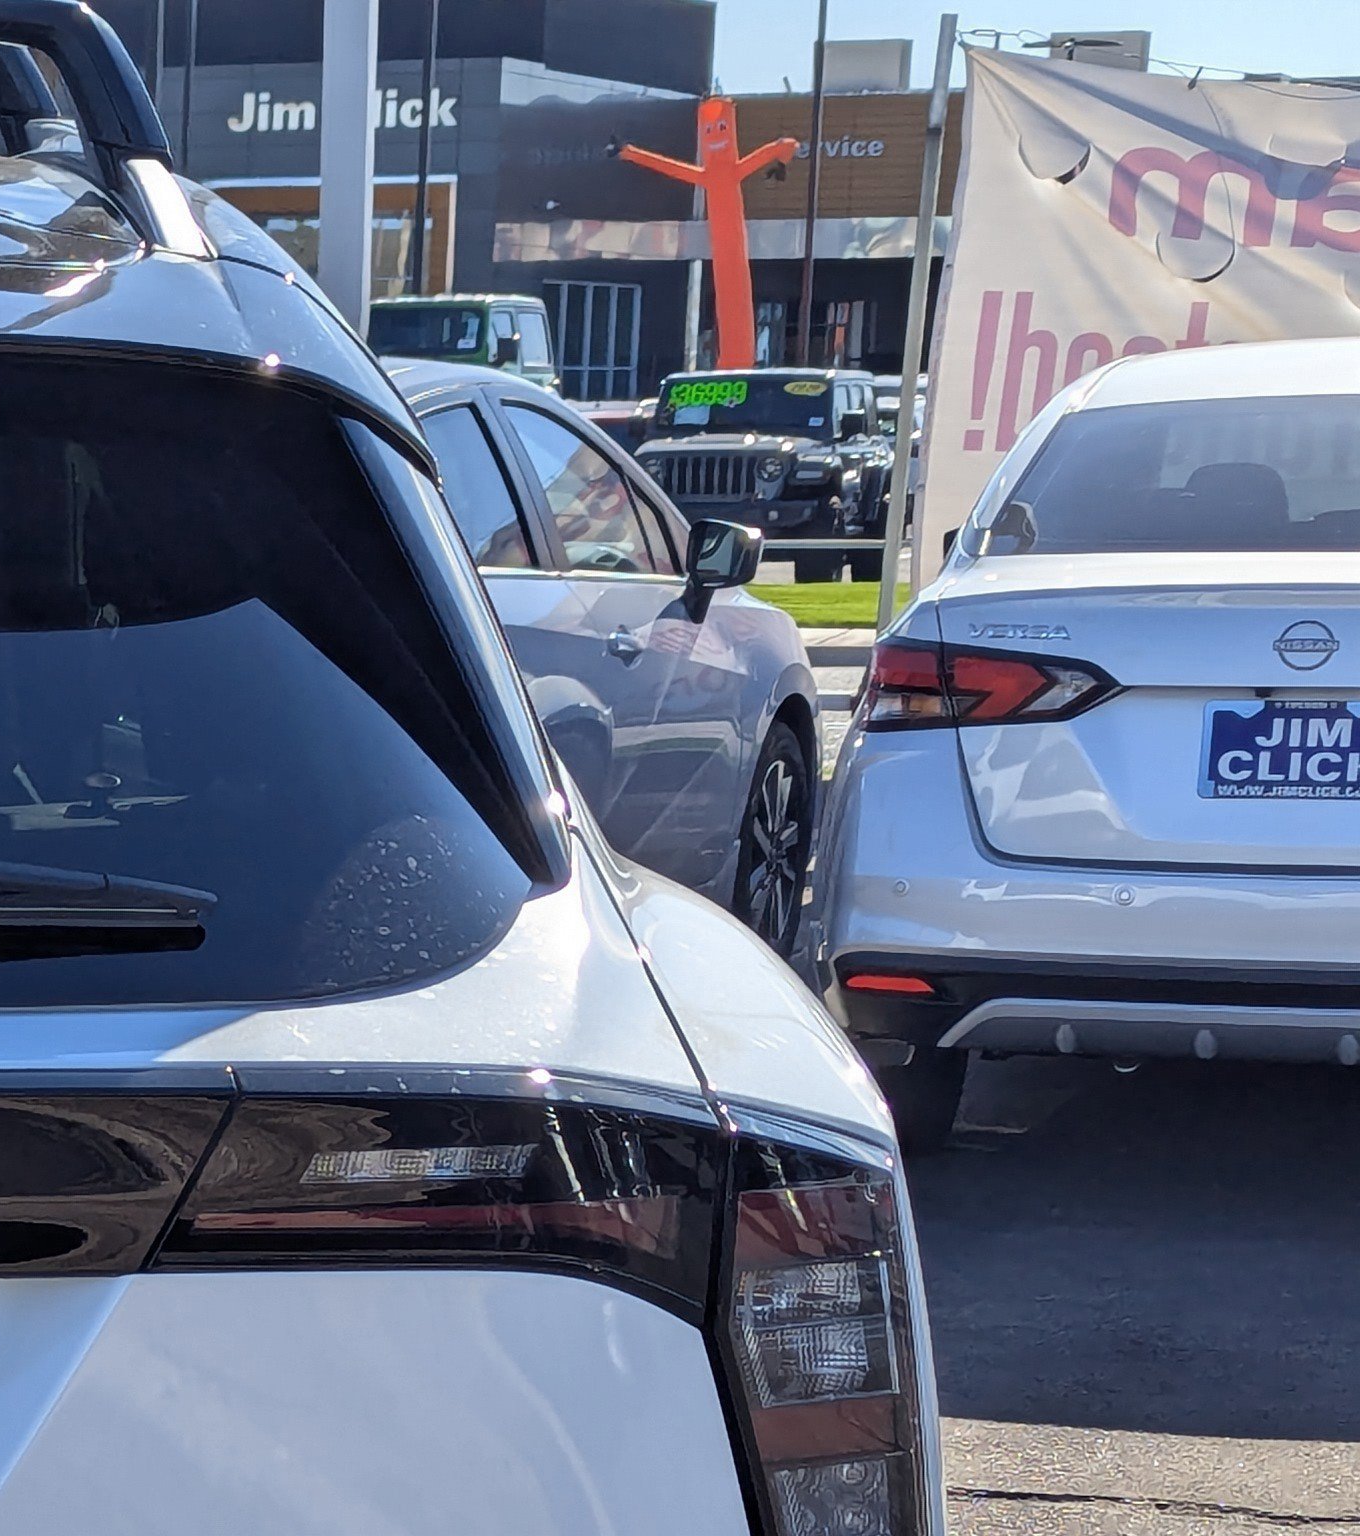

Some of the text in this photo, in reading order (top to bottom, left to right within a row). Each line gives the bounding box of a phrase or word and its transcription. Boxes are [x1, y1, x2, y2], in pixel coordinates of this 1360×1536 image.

[227, 88, 458, 132] Jim lick
[969, 623, 1071, 640] VERSA
[1276, 640, 1337, 651] NISSAN
[1255, 718, 1353, 747] JIM
